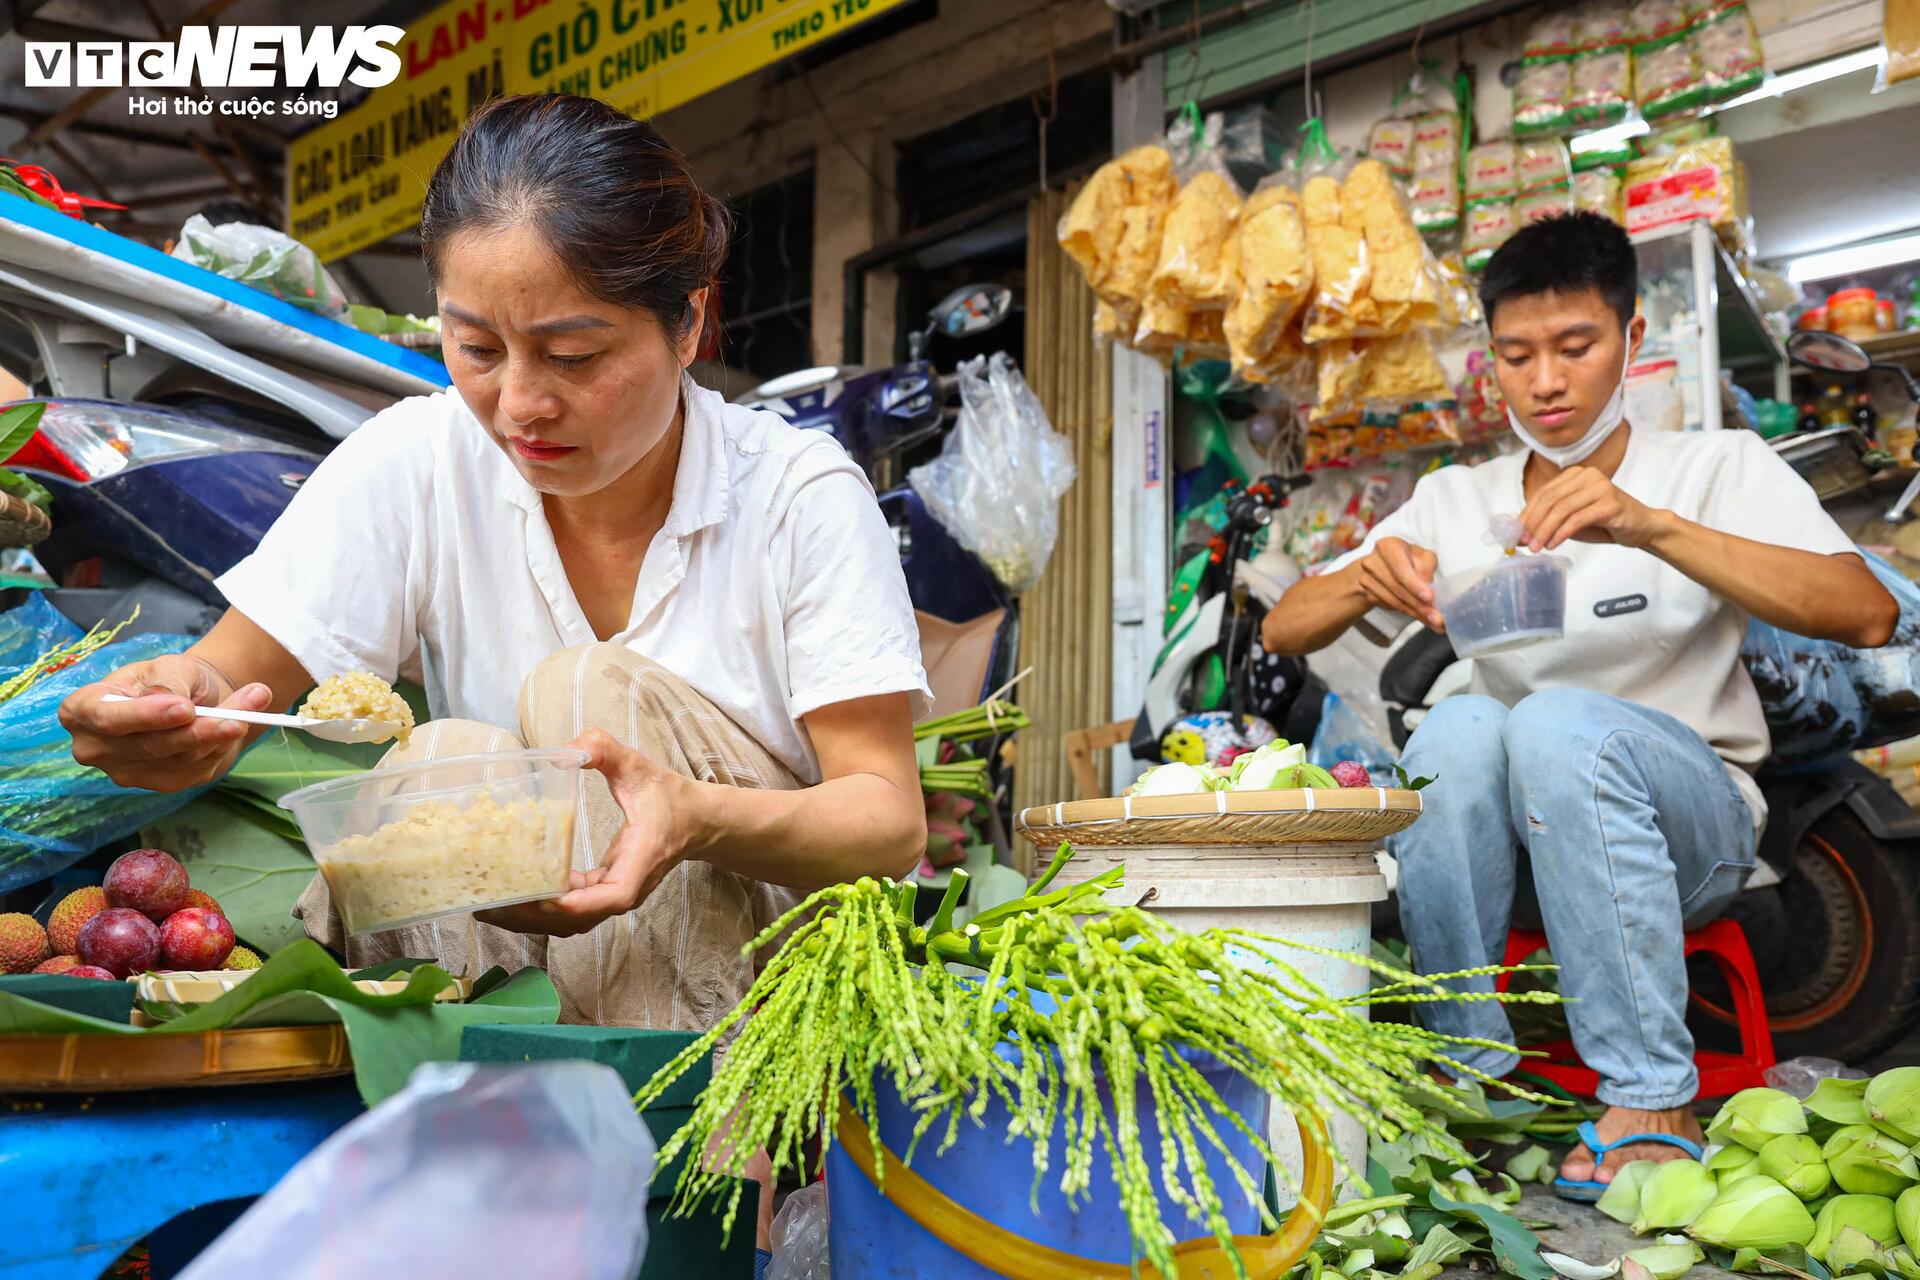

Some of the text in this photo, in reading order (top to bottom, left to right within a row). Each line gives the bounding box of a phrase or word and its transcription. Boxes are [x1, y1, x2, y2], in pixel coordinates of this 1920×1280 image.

[407, 0, 486, 80] LAN
[529, 1, 599, 80] GIÒ
[773, 11, 824, 50] THEO
